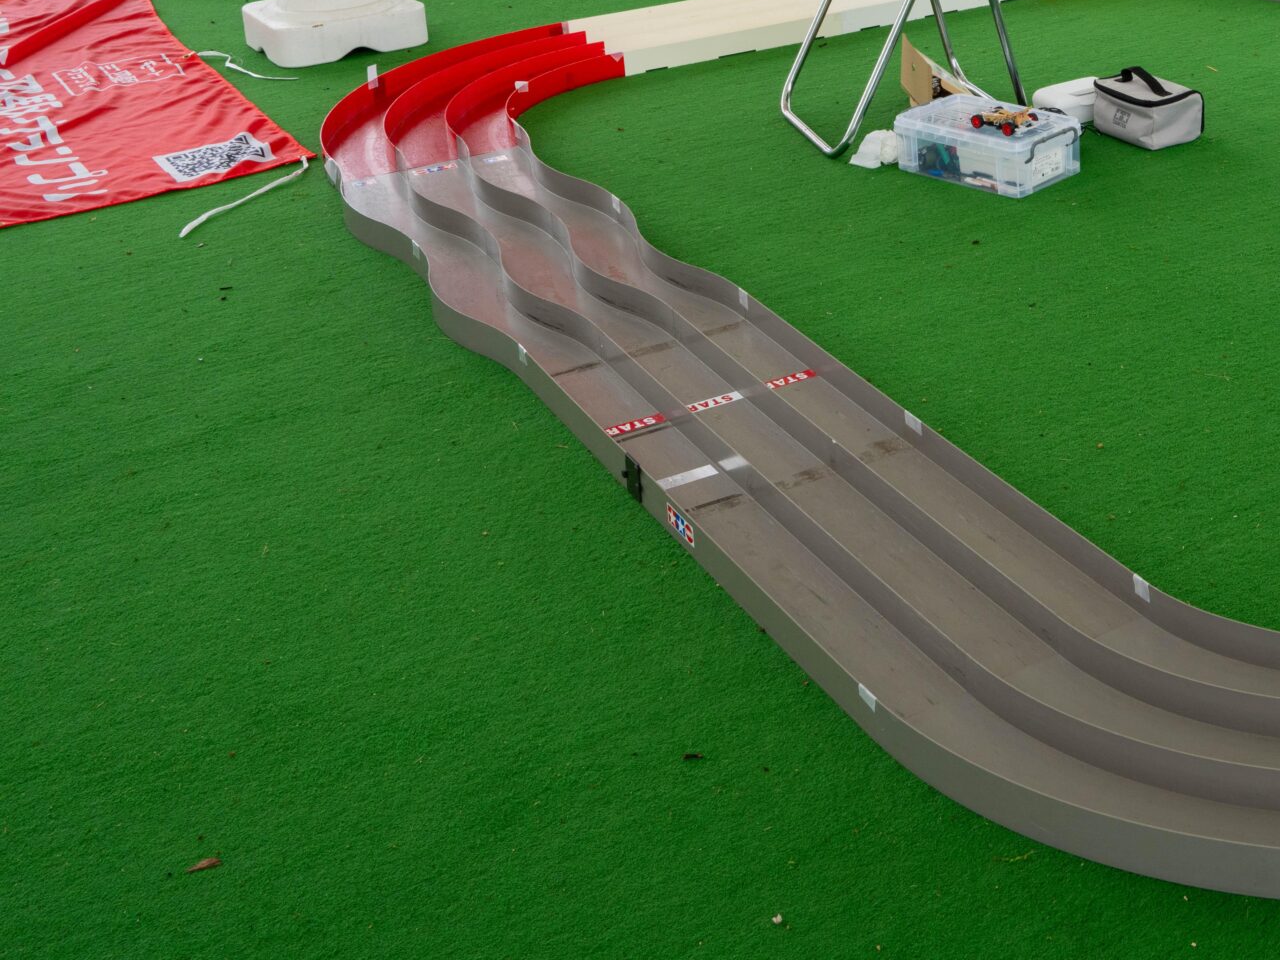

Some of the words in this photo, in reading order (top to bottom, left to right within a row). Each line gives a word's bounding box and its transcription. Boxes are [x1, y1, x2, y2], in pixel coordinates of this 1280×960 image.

[766, 372, 809, 389] STAR
[688, 394, 734, 413] STAR
[605, 417, 656, 436] STAR
